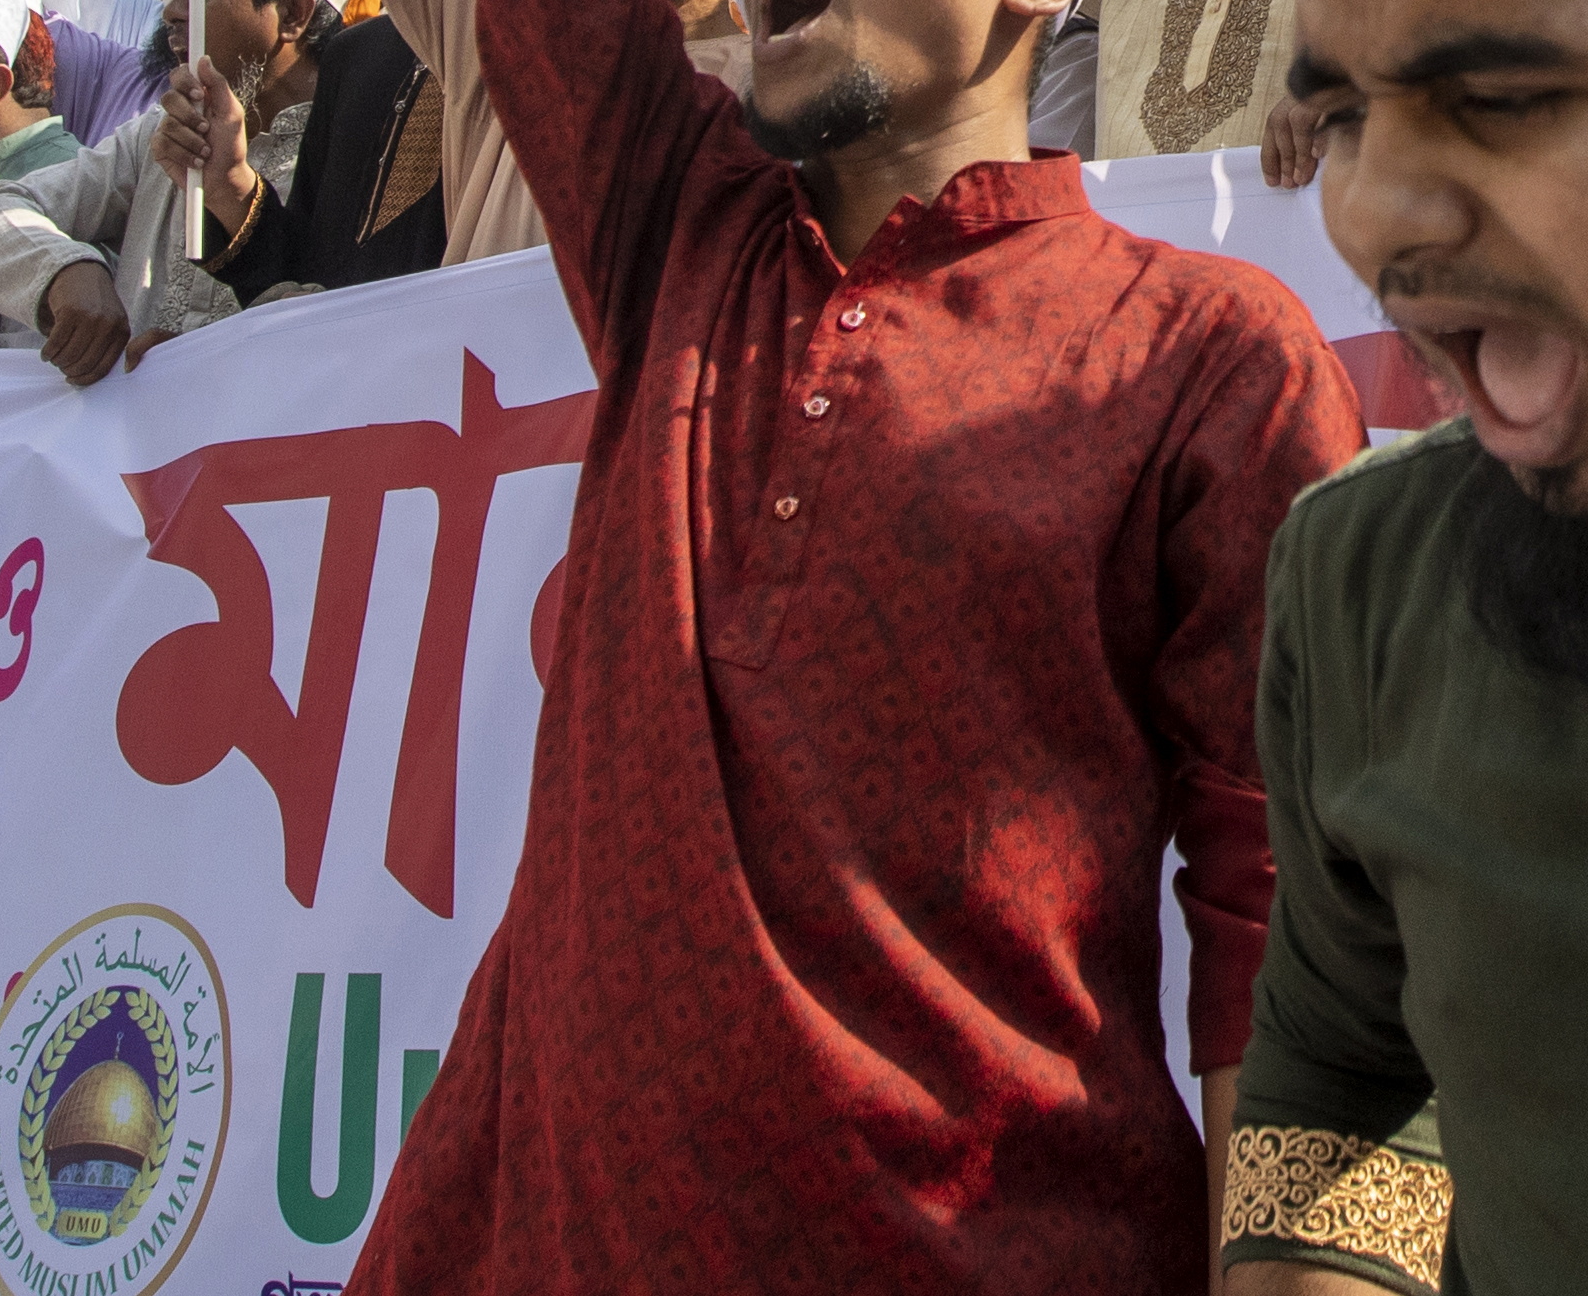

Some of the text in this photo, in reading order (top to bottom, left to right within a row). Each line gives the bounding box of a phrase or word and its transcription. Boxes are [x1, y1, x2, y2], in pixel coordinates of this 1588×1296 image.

[95, 927, 192, 997] المسلمة
[18, 1251, 118, 1296] MUSLIM
[122, 1139, 205, 1283] UMMAH
[65, 1215, 102, 1234] UMU
